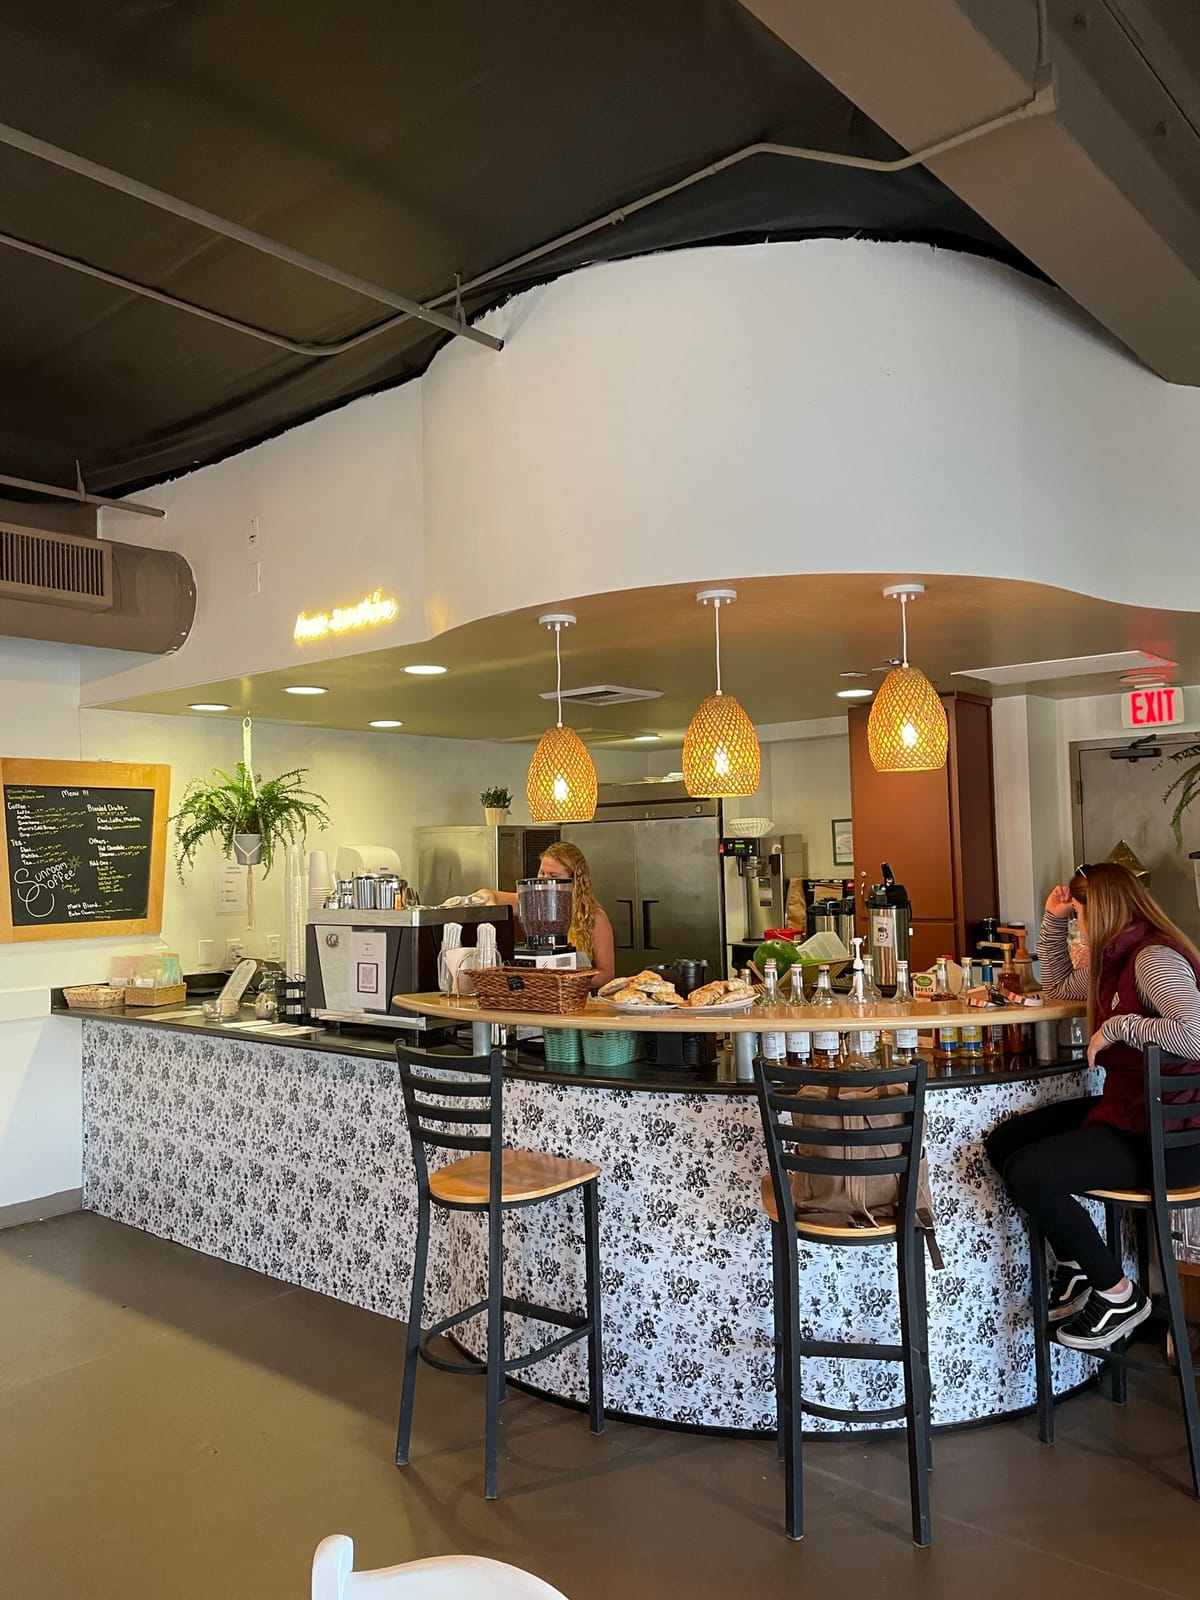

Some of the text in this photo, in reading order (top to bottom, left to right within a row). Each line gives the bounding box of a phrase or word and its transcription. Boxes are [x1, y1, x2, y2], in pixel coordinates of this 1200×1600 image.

[1131, 689, 1174, 725] EXIT
[61, 789, 79, 798] Menu
[14, 862, 68, 903] Sunroom
[26, 868, 76, 918] Coffee
